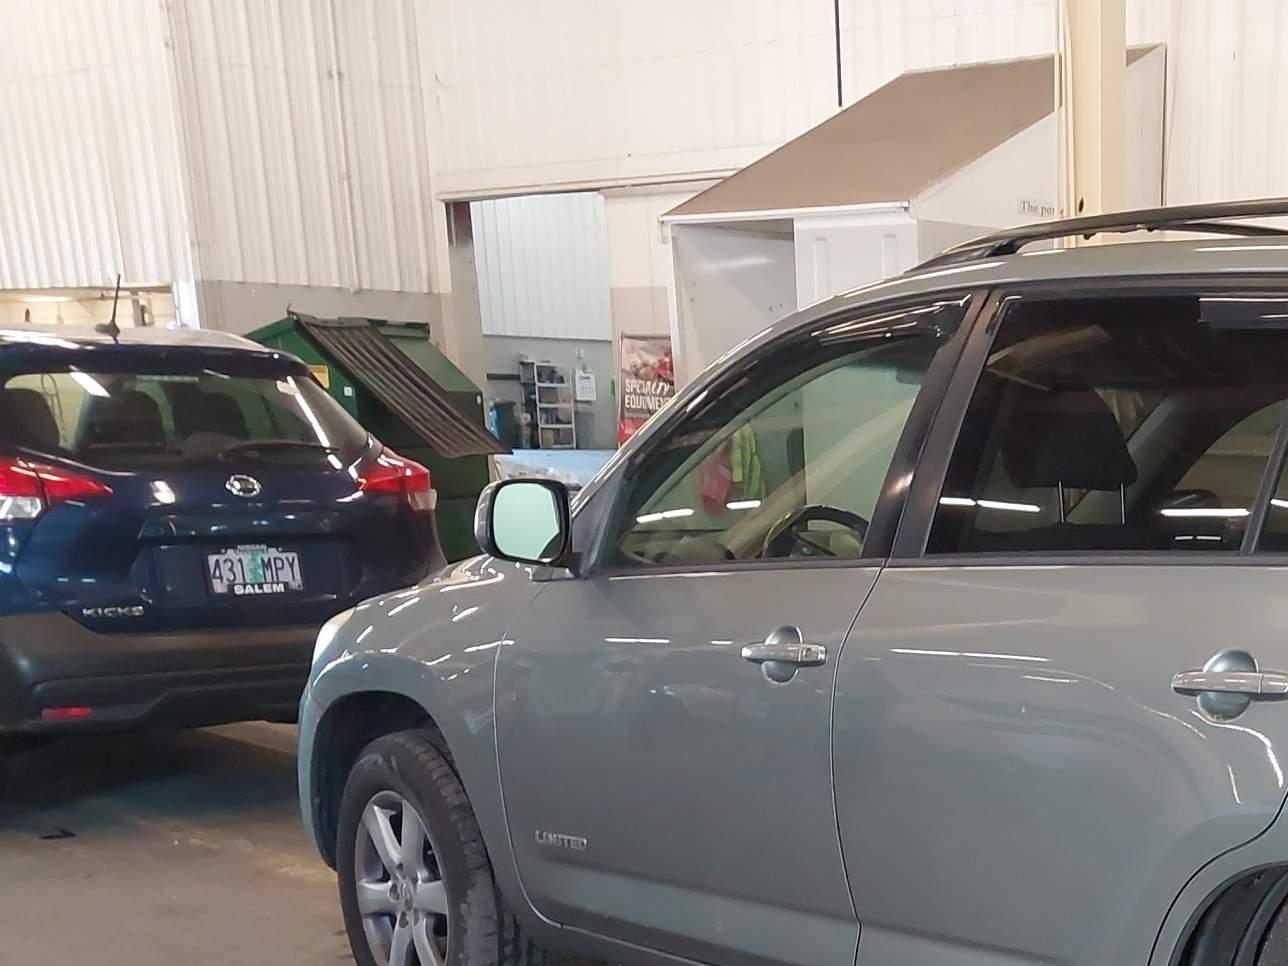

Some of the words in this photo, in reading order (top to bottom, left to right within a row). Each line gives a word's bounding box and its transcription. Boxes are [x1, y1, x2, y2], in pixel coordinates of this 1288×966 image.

[212, 558, 247, 585] 431
[260, 556, 296, 584] MPY
[233, 583, 285, 595] SALEM
[82, 605, 145, 617] KICKS
[535, 830, 588, 851] LIMITED
